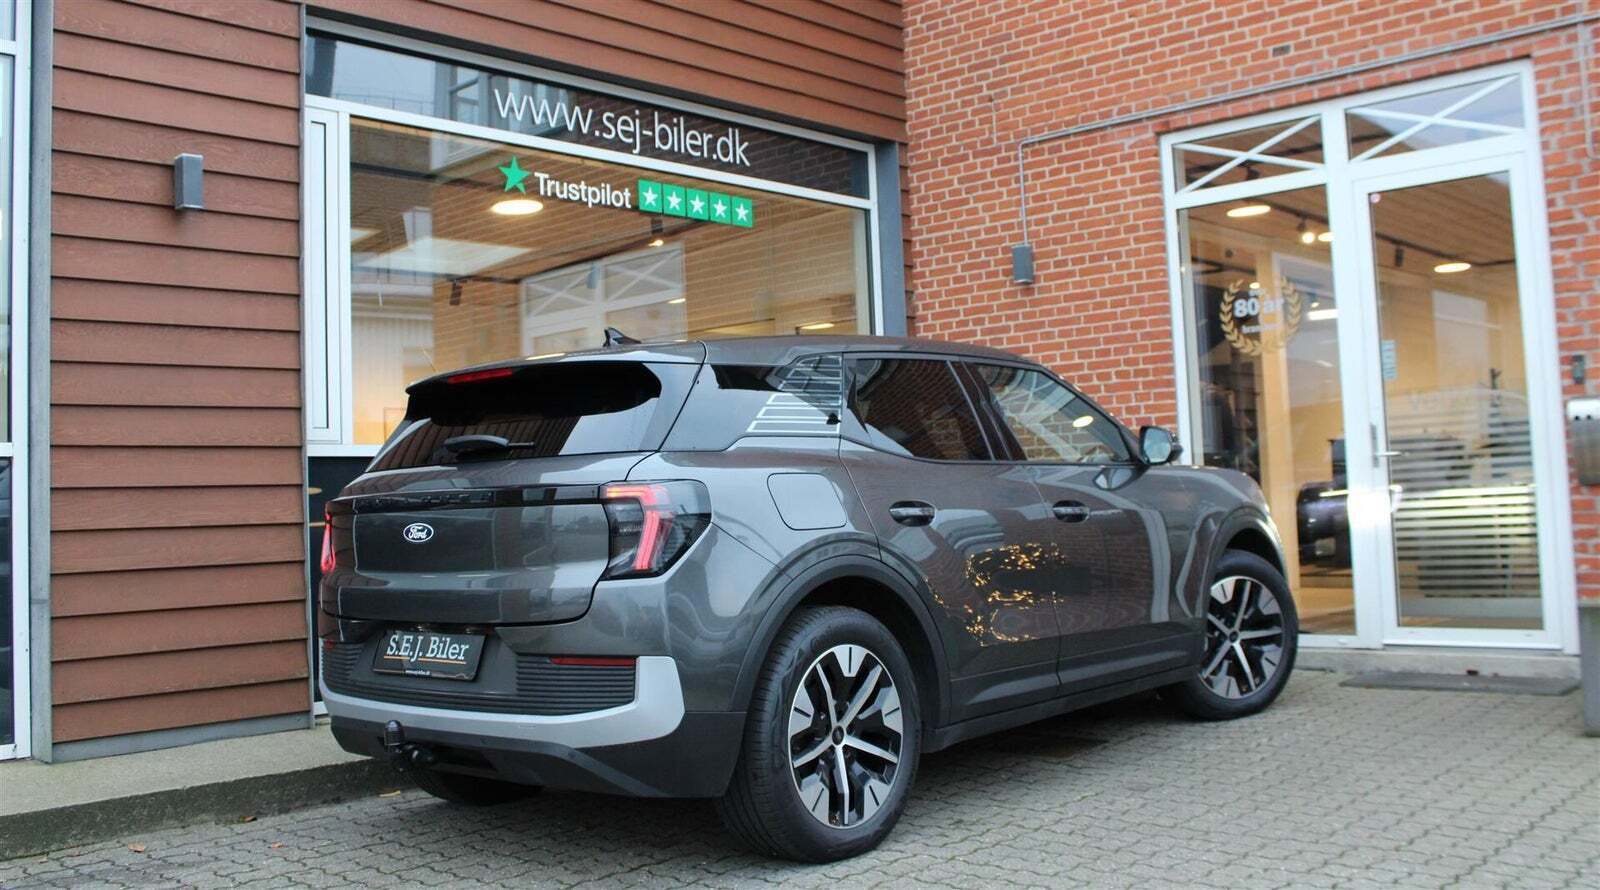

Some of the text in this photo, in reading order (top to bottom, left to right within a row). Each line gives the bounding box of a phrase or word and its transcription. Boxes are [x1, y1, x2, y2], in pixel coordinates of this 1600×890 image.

[494, 88, 751, 167] www.sej-biler.dk
[534, 171, 632, 208] Trustpilot
[1233, 298, 1260, 318] 80
[408, 525, 428, 539] Ford
[386, 633, 470, 662] S.E.J. Biler
